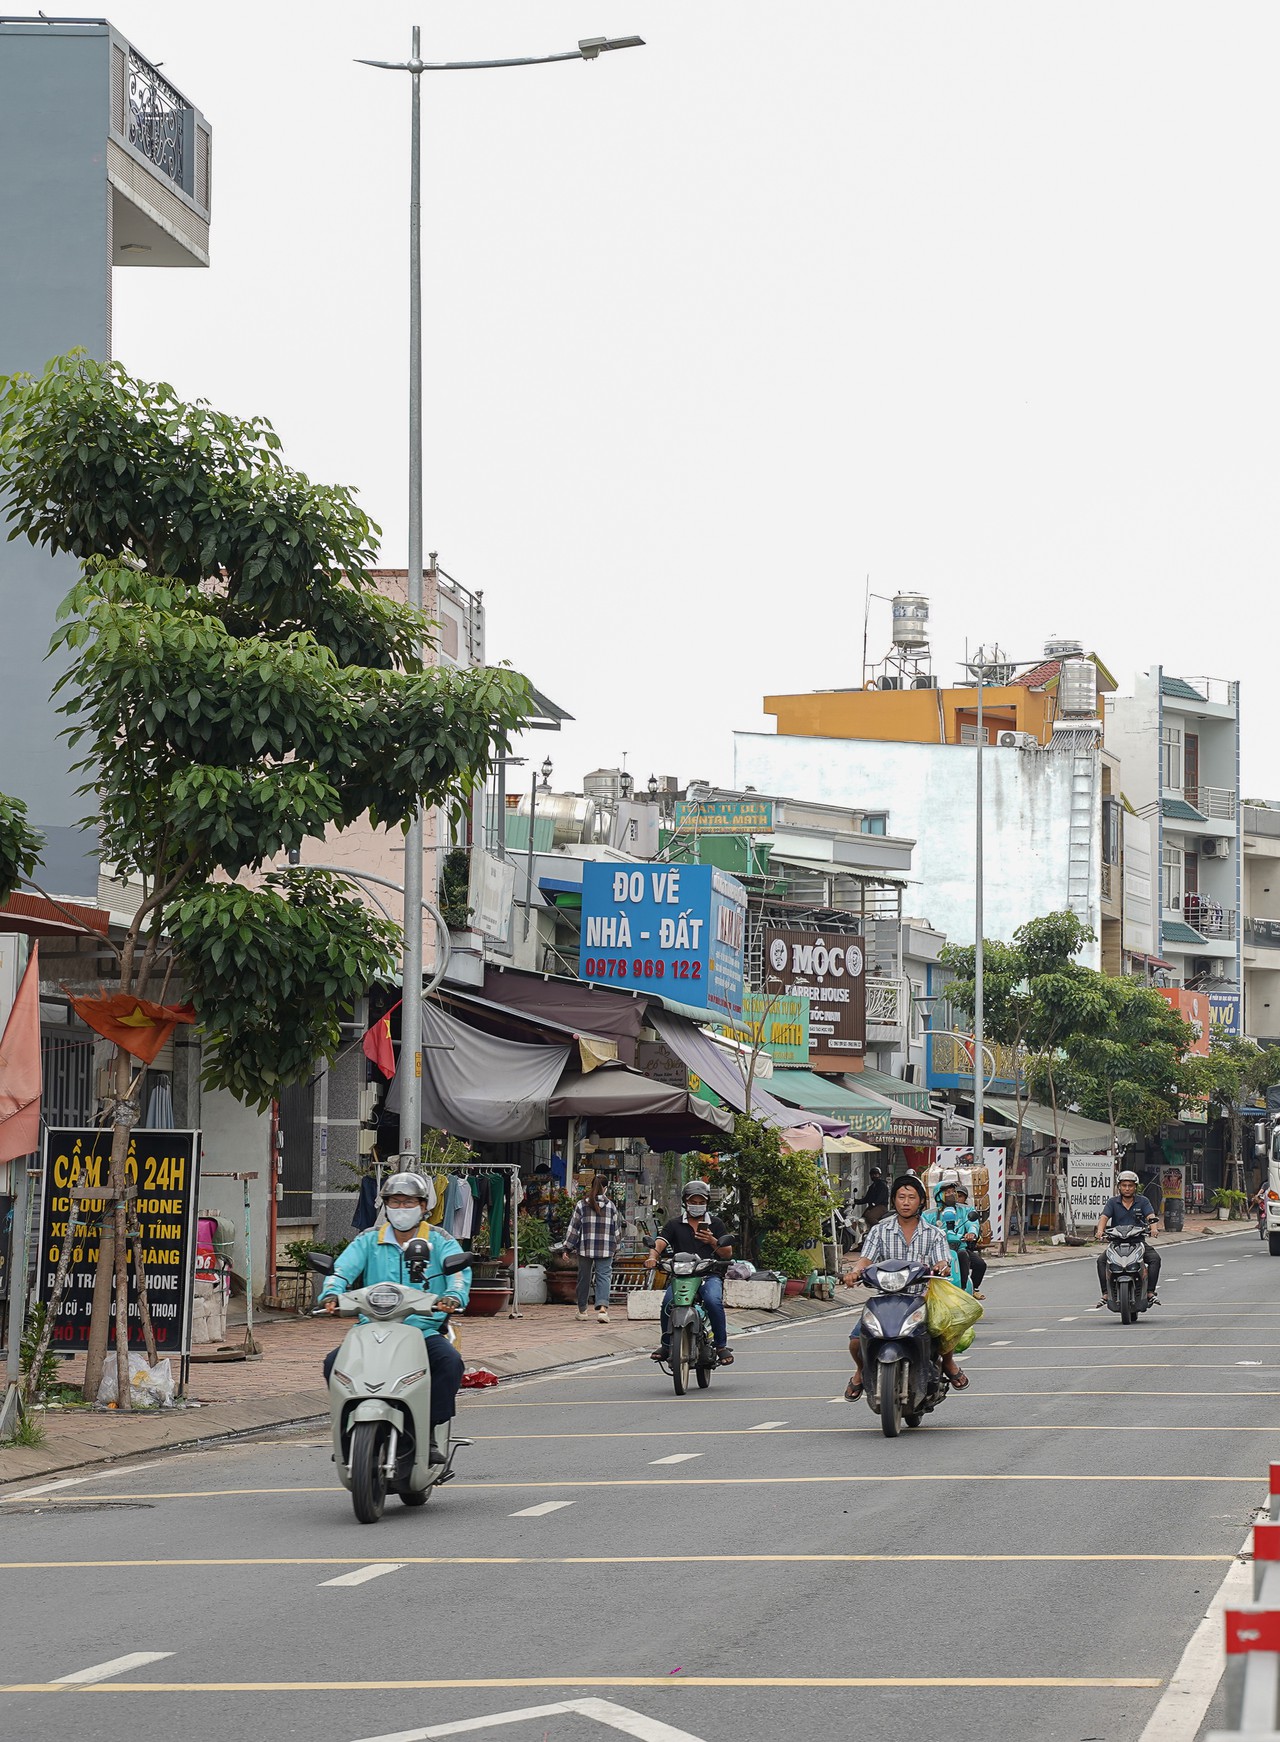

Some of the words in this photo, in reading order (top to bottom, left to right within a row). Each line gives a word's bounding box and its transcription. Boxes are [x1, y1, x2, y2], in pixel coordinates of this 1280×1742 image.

[732, 815, 767, 825] MATH
[612, 871, 645, 903] ĐO
[651, 867, 680, 904] VẼ
[586, 910, 632, 948] NHÀ
[659, 908, 703, 950] ĐẤT
[585, 957, 628, 978] 0978
[633, 958, 665, 978] 969
[671, 959, 702, 979] 122
[791, 937, 845, 983] MỘC
[820, 986, 850, 1003] HOUSE
[913, 1125, 937, 1140] HOUSE
[53, 1138, 102, 1189] CẦM
[144, 1156, 185, 1191] 24H
[1071, 1173, 1088, 1190] GỘI
[1091, 1171, 1111, 1188] ĐẦU
[148, 1219, 181, 1240] TỈNH
[47, 1272, 74, 1288] BN
[133, 1274, 178, 1290] IHONE
[65, 1299, 78, 1316] CŨ
[152, 1303, 177, 1321] THOẠI
